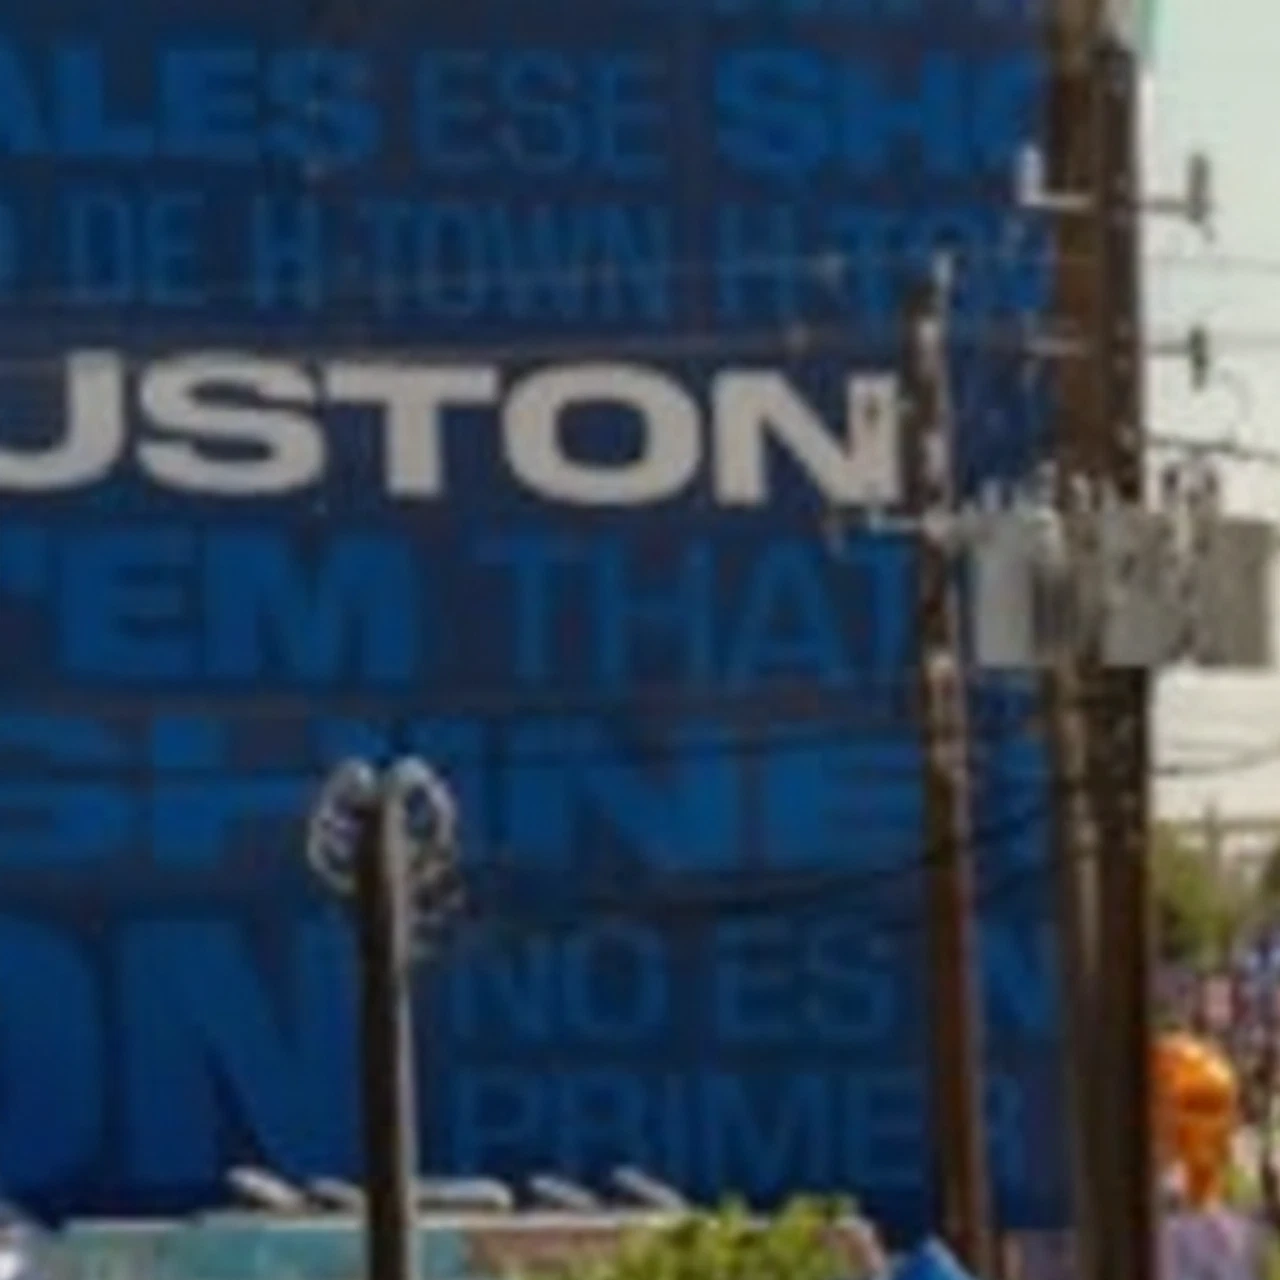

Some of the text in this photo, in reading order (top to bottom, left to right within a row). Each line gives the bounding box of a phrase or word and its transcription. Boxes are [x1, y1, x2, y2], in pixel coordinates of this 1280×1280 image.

[416, 46, 672, 176] ESE
[68, 192, 203, 304] DE
[0, 348, 903, 505] USTON
[472, 520, 918, 692] THAT
[448, 922, 670, 1042] NO
[716, 915, 898, 1042] ES
